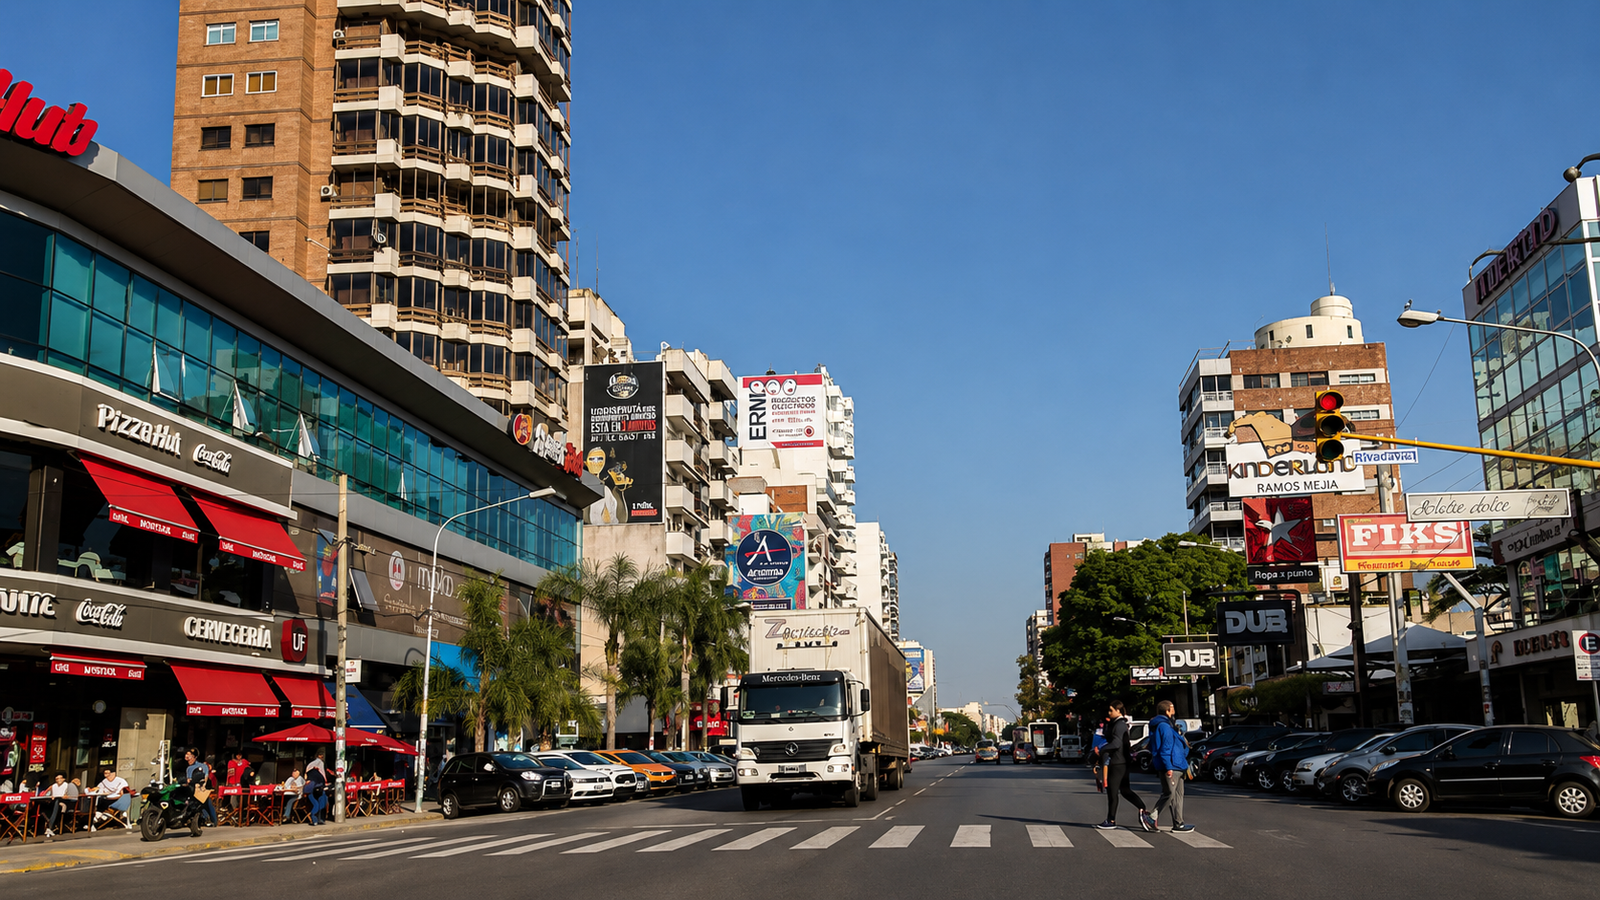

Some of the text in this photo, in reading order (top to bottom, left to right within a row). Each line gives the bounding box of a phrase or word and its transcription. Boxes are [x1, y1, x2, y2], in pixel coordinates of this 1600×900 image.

[1257, 479, 1339, 493] RAMOS MEJIA
[1254, 570, 1278, 580] Ropa
[1224, 609, 1288, 634] DUB
[1168, 648, 1216, 668] DUB
